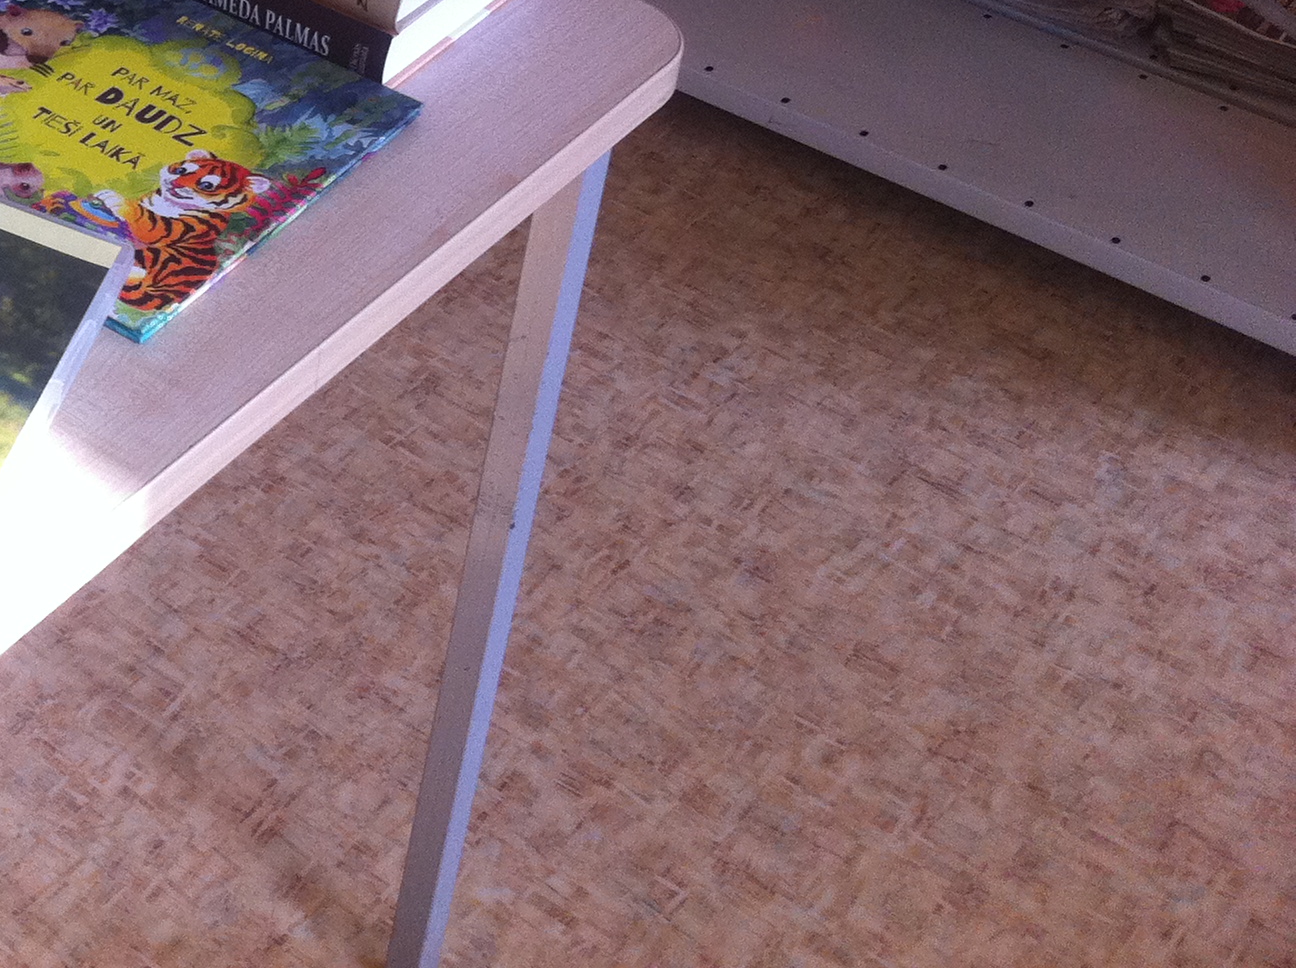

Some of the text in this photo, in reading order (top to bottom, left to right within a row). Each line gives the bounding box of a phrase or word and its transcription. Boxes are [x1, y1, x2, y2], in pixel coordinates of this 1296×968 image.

[226, 38, 275, 64] LOGINA
[265, 8, 332, 58] PALMAS
[111, 66, 150, 90] PAR
[56, 72, 208, 147] PAR DAUDZ
[92, 114, 123, 133] UN
[32, 105, 147, 170] TIEŠI LAIKĀ
